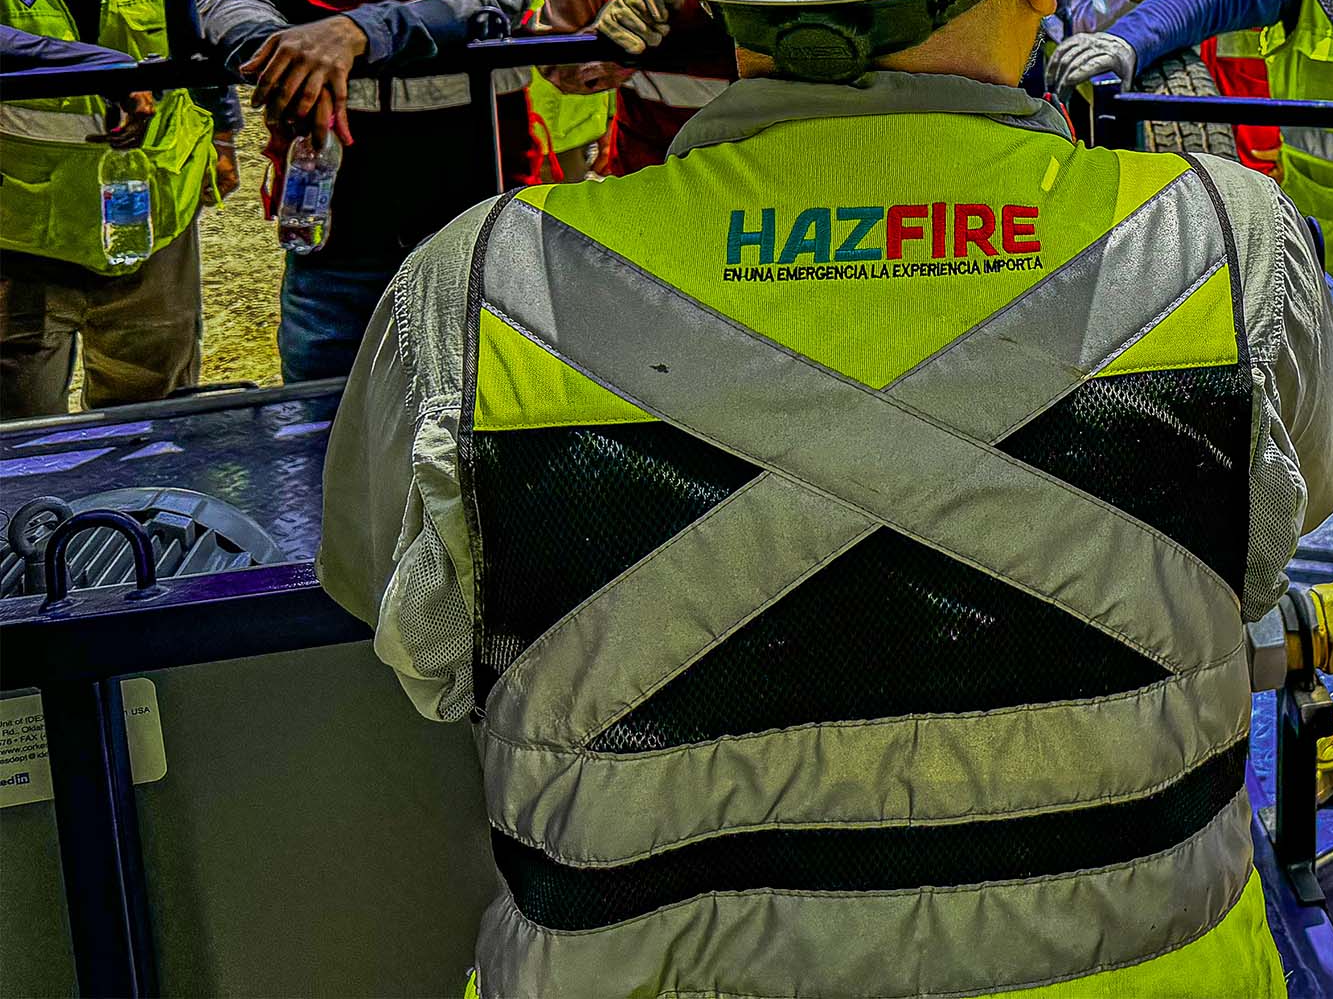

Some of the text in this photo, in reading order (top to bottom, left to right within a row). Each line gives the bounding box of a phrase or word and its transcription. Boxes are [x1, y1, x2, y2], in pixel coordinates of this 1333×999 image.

[726, 202, 1042, 265] HAZFIRE
[777, 264, 869, 282] EMERGENCIA
[871, 263, 890, 280] LA
[892, 260, 981, 279] EXPERIENCIA
[983, 256, 1044, 276] IMPORTA
[131, 706, 151, 716] USA
[20, 734, 38, 743] FAX
